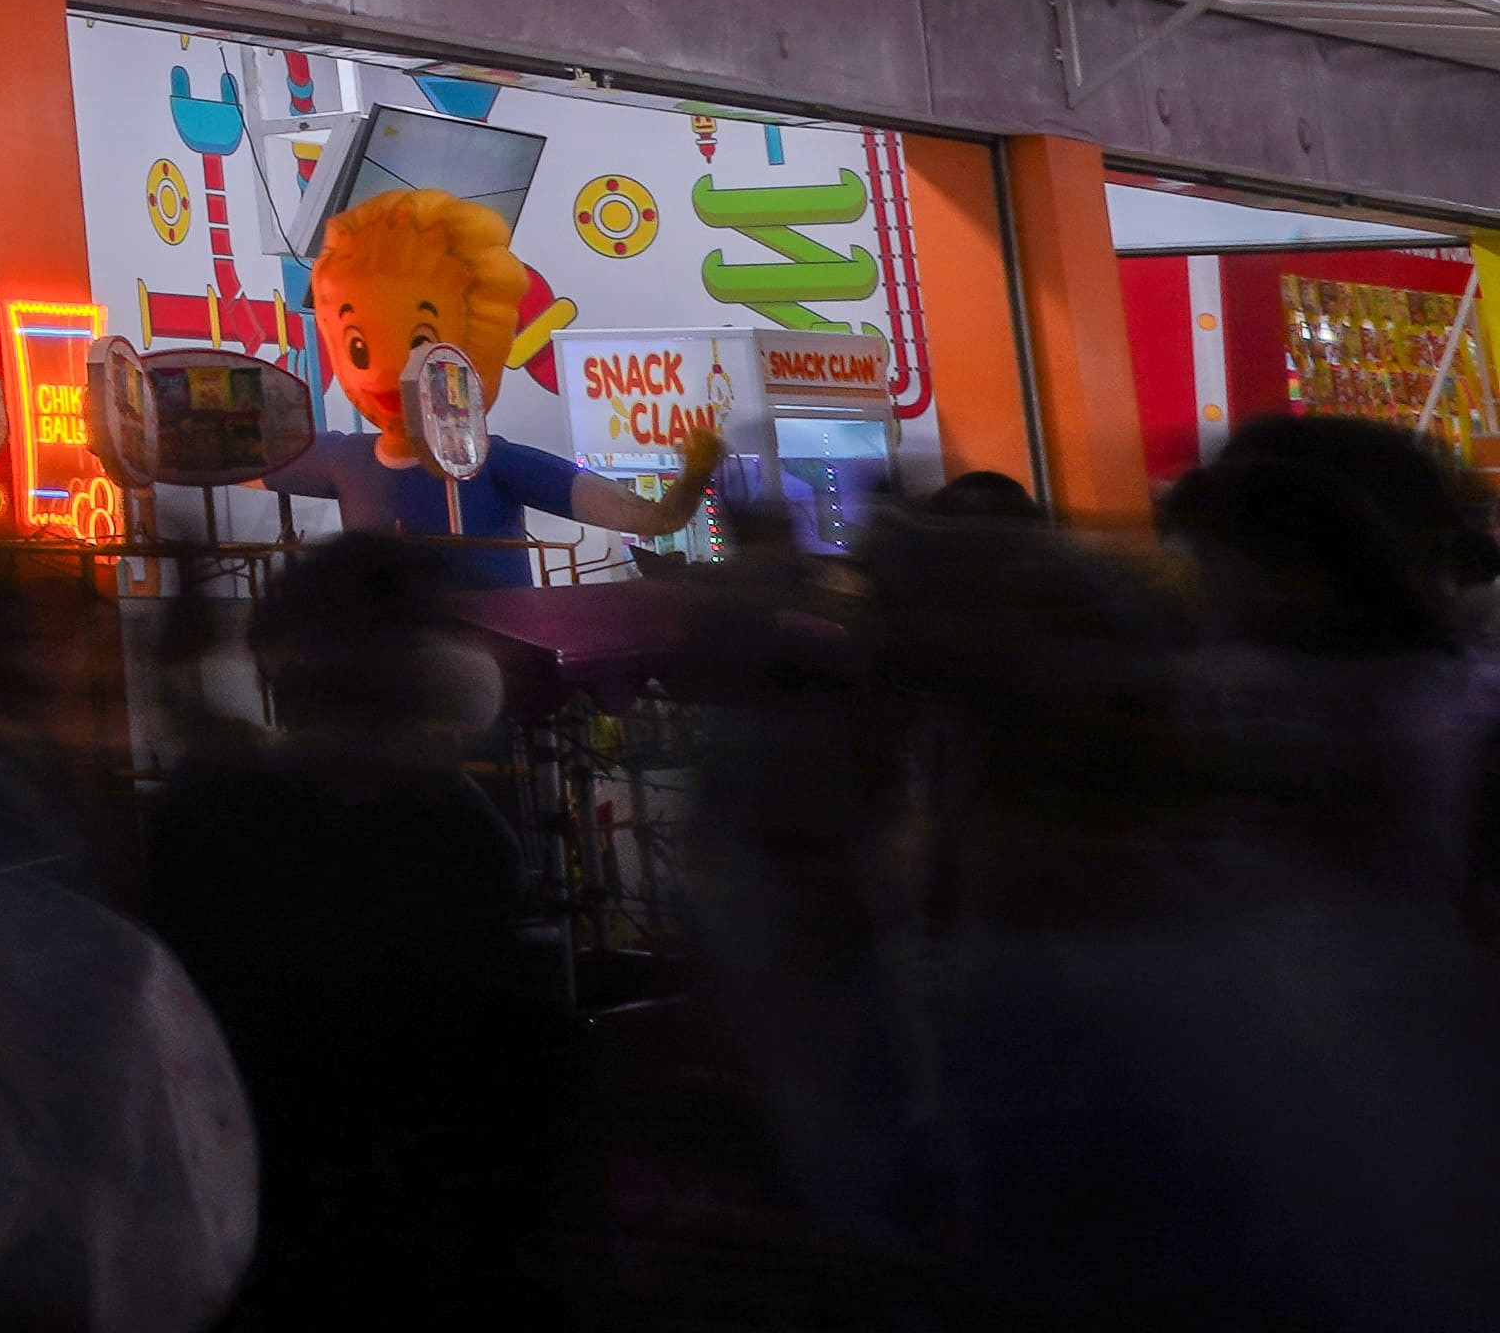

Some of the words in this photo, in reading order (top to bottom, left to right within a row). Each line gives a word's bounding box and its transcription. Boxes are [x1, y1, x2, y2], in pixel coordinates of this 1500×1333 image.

[583, 349, 685, 400] SNACK
[770, 349, 827, 381] SNACK
[828, 354, 876, 383] CLAW
[630, 400, 716, 447] CLAW
